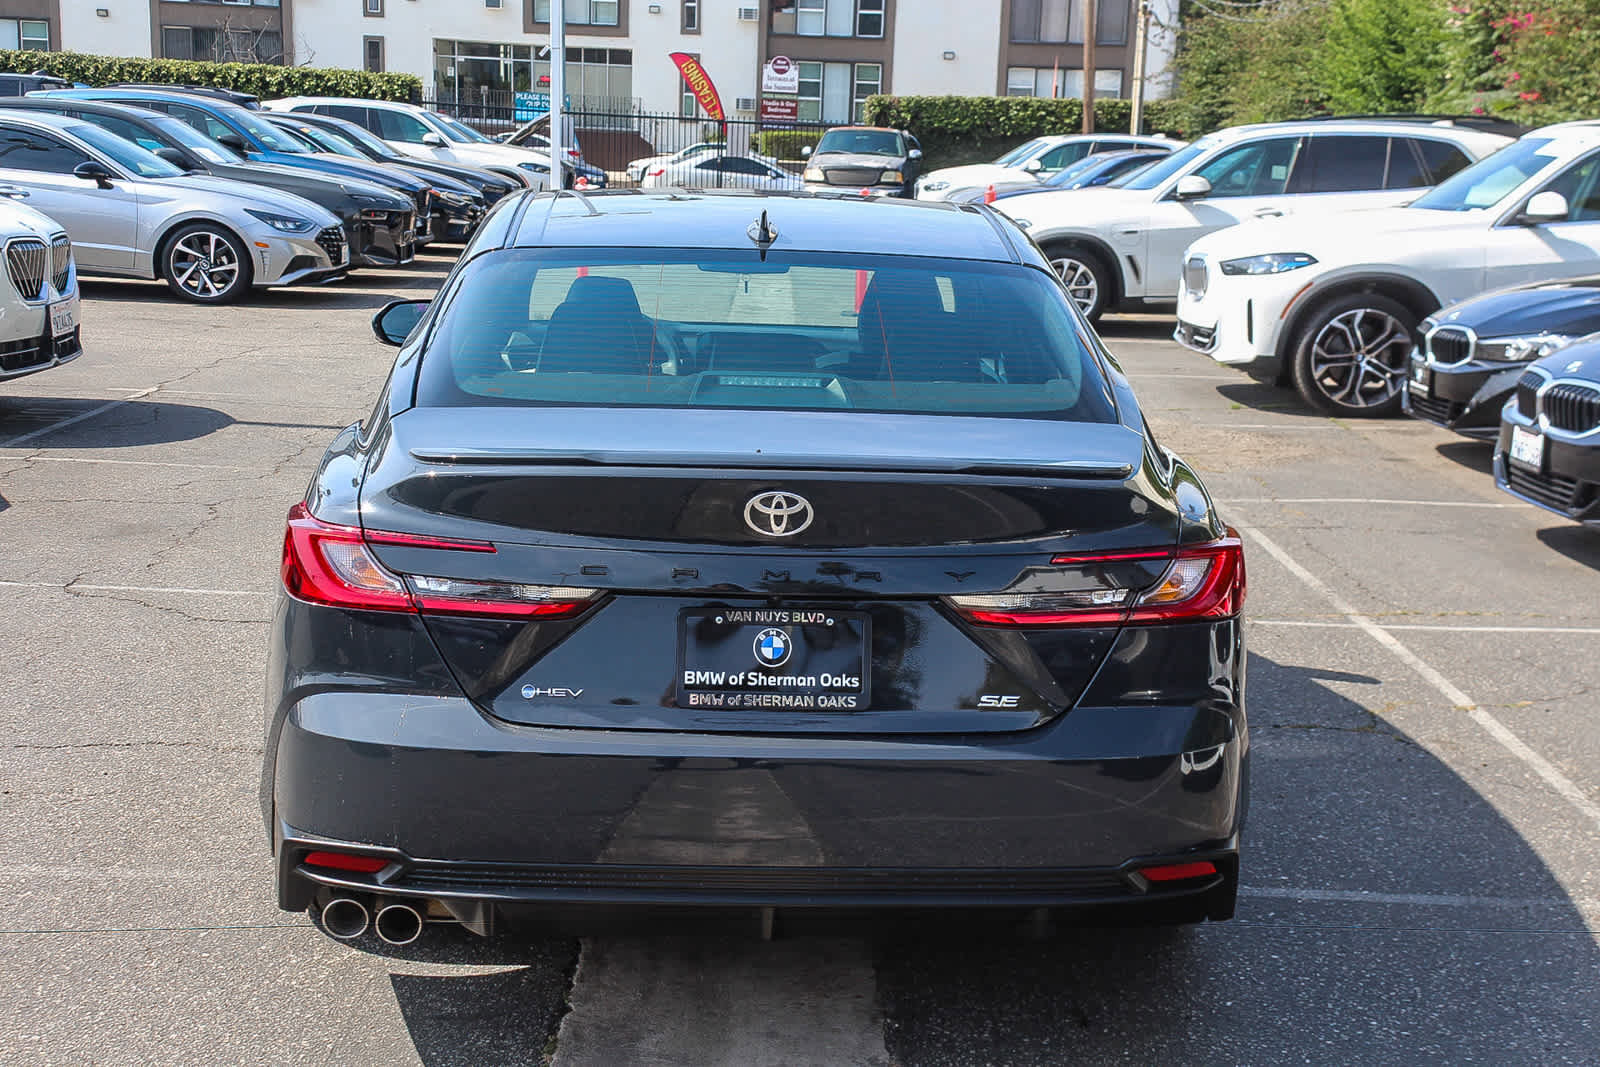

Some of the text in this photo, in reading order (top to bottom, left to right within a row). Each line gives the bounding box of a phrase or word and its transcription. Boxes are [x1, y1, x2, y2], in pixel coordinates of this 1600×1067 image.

[515, 92, 541, 101] PLEASE
[580, 564, 976, 583] CAMRY
[725, 610, 825, 623] VAN NUYS BLVD
[684, 670, 860, 688] BMW of Sherman Oaks
[533, 686, 584, 698] HEV
[689, 693, 857, 708] BMW of SHERMAN OAKS
[977, 695, 1021, 707] SE
